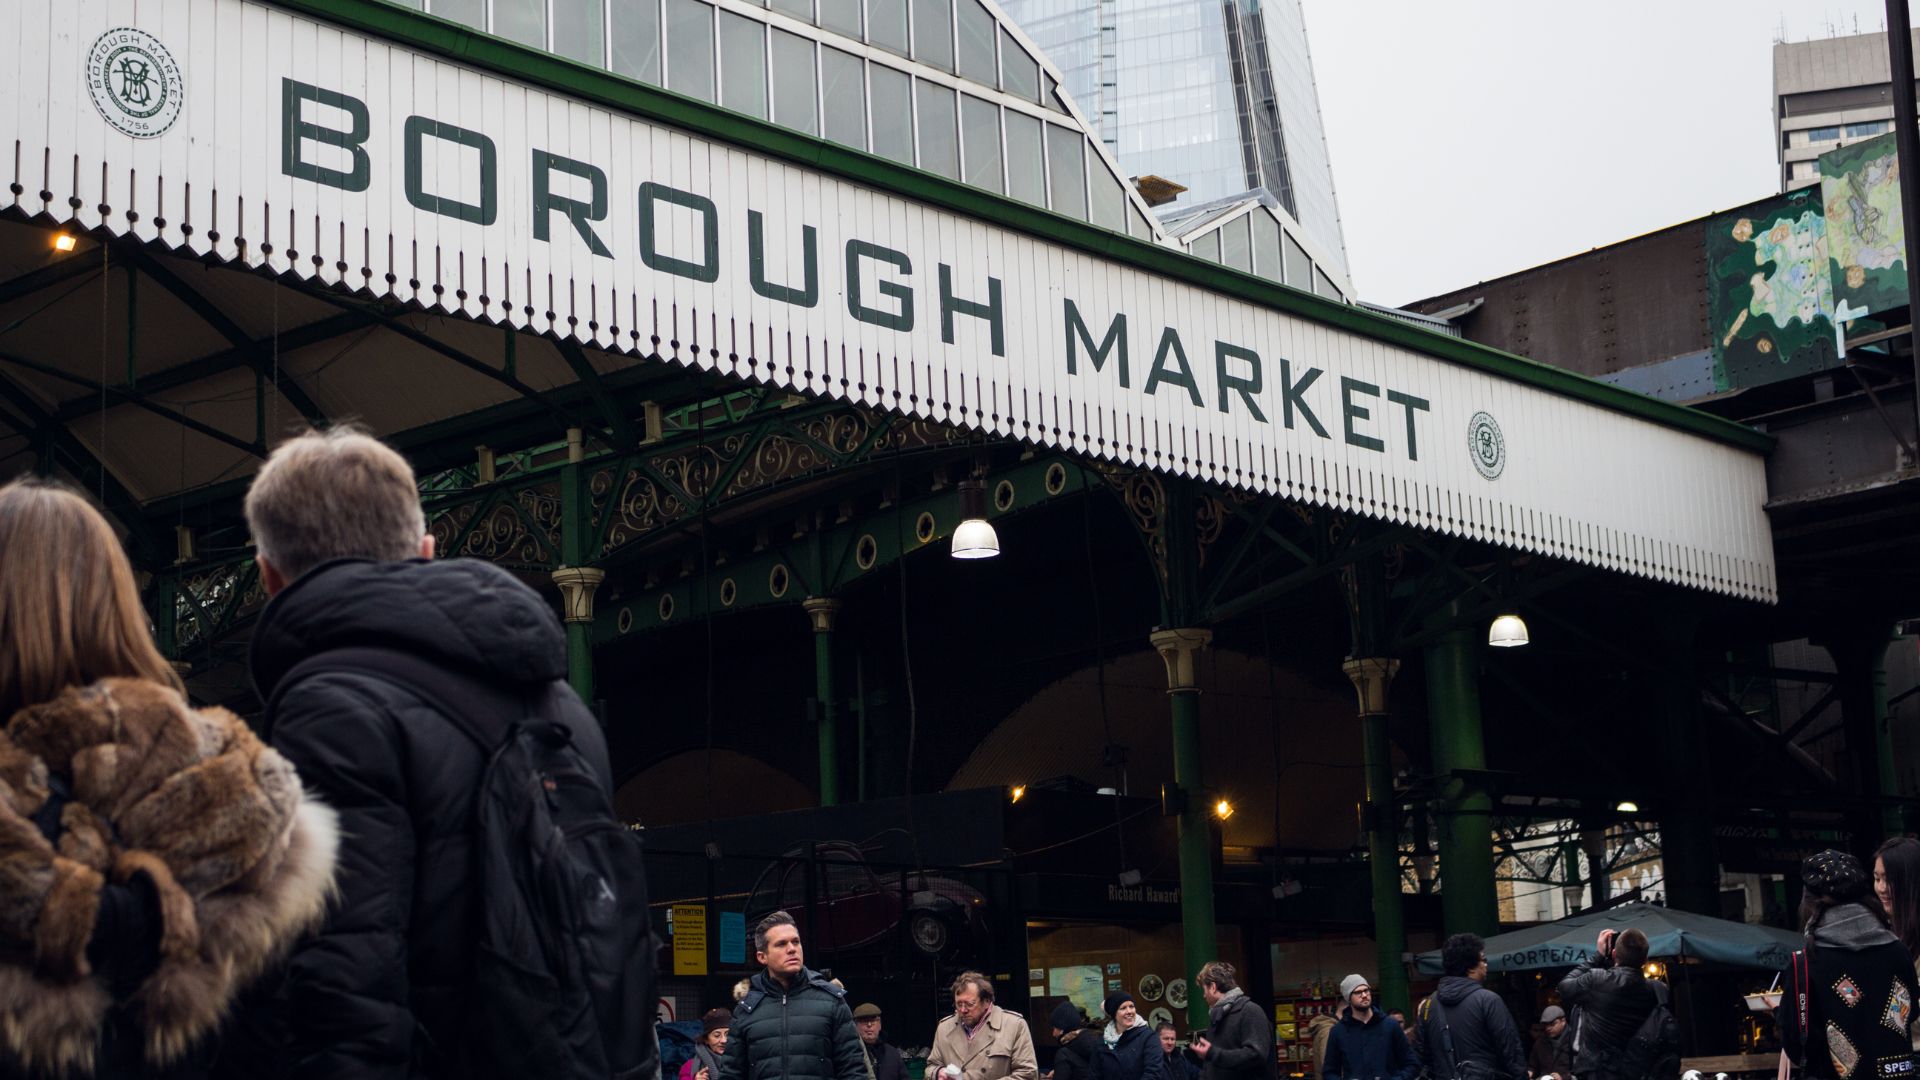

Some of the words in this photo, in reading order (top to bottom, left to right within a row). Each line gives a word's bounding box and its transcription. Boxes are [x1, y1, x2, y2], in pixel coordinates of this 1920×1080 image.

[92, 34, 140, 89] BOROUGH
[147, 43, 178, 109] MARKET
[121, 117, 149, 130] 1756
[282, 79, 1004, 357] BOROUGH
[1064, 298, 1430, 461] MARKET
[1108, 884, 1143, 901] Richard
[1146, 886, 1181, 904] Haward'
[674, 908, 704, 917] ATTENTION
[1502, 946, 1587, 966] PORTEÑA
